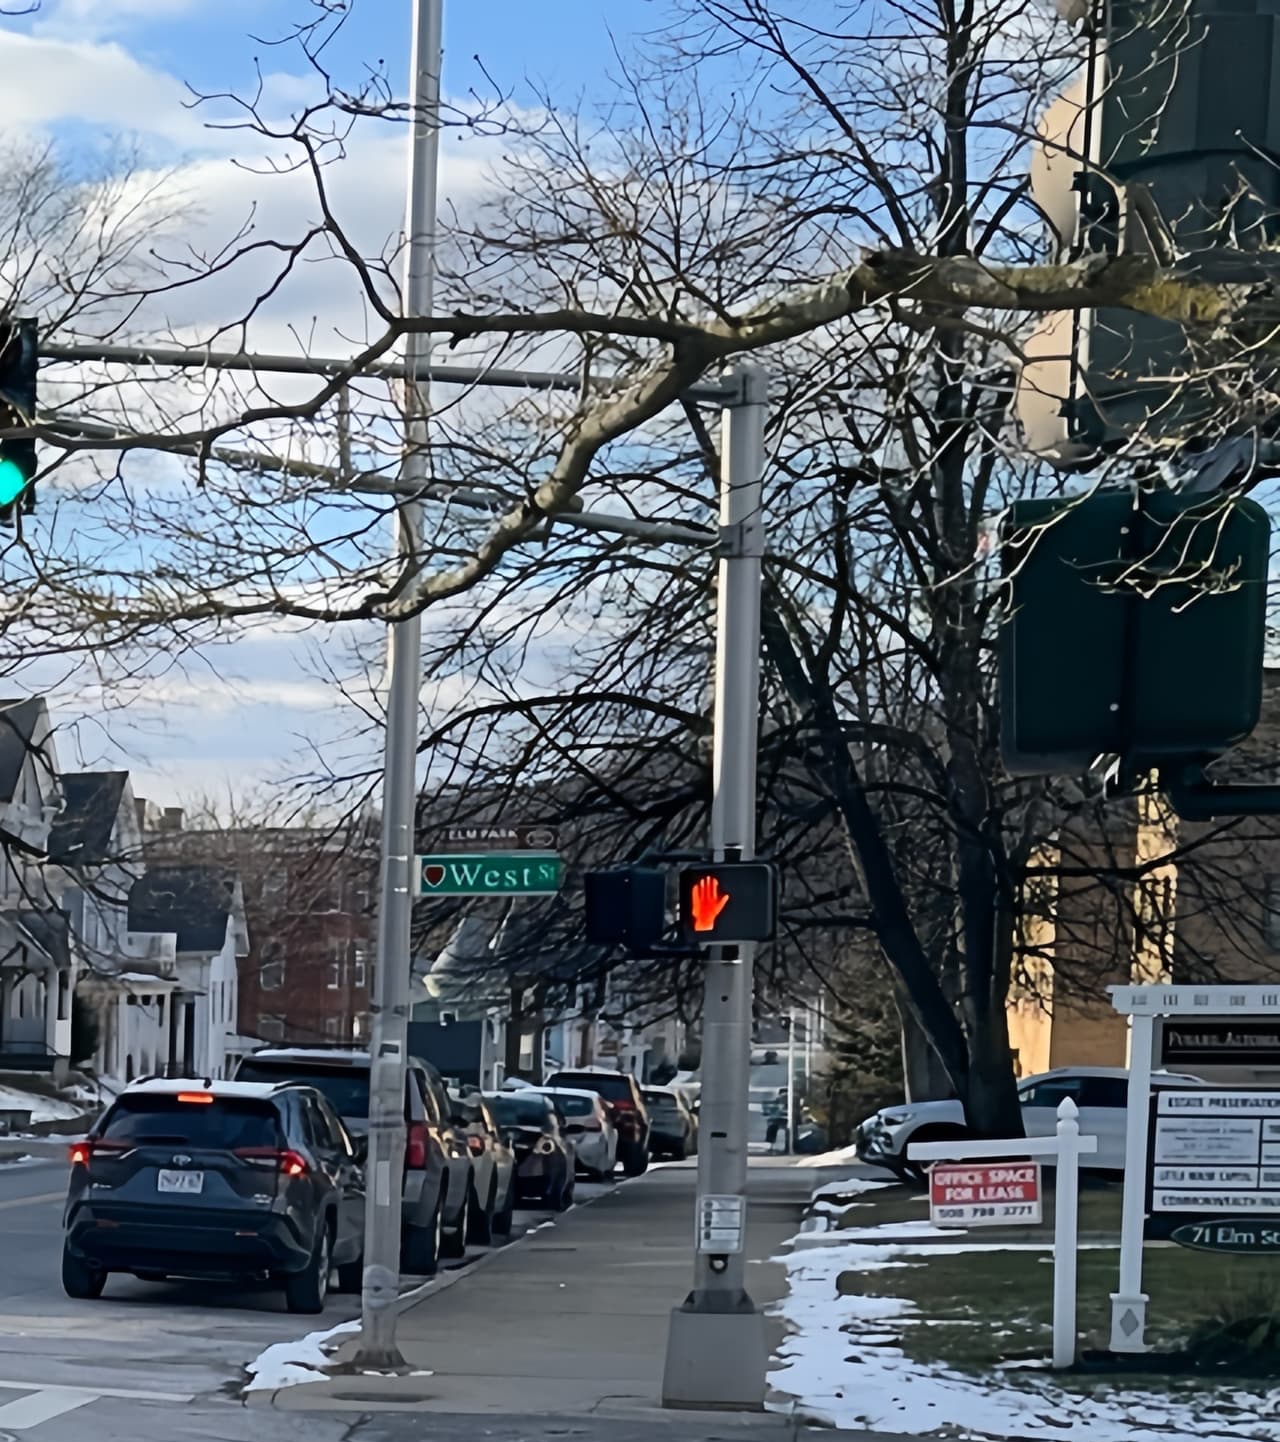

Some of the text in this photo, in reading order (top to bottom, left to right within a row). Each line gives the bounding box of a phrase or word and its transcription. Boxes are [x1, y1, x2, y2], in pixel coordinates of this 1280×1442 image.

[448, 829, 477, 840] ELM
[449, 863, 555, 887] West St
[934, 1168, 1035, 1186] OFFICE SPACE
[945, 1185, 1025, 1200] FOR LEASE
[1192, 1227, 1211, 1243] 71
[1217, 1227, 1255, 1244] Elm
